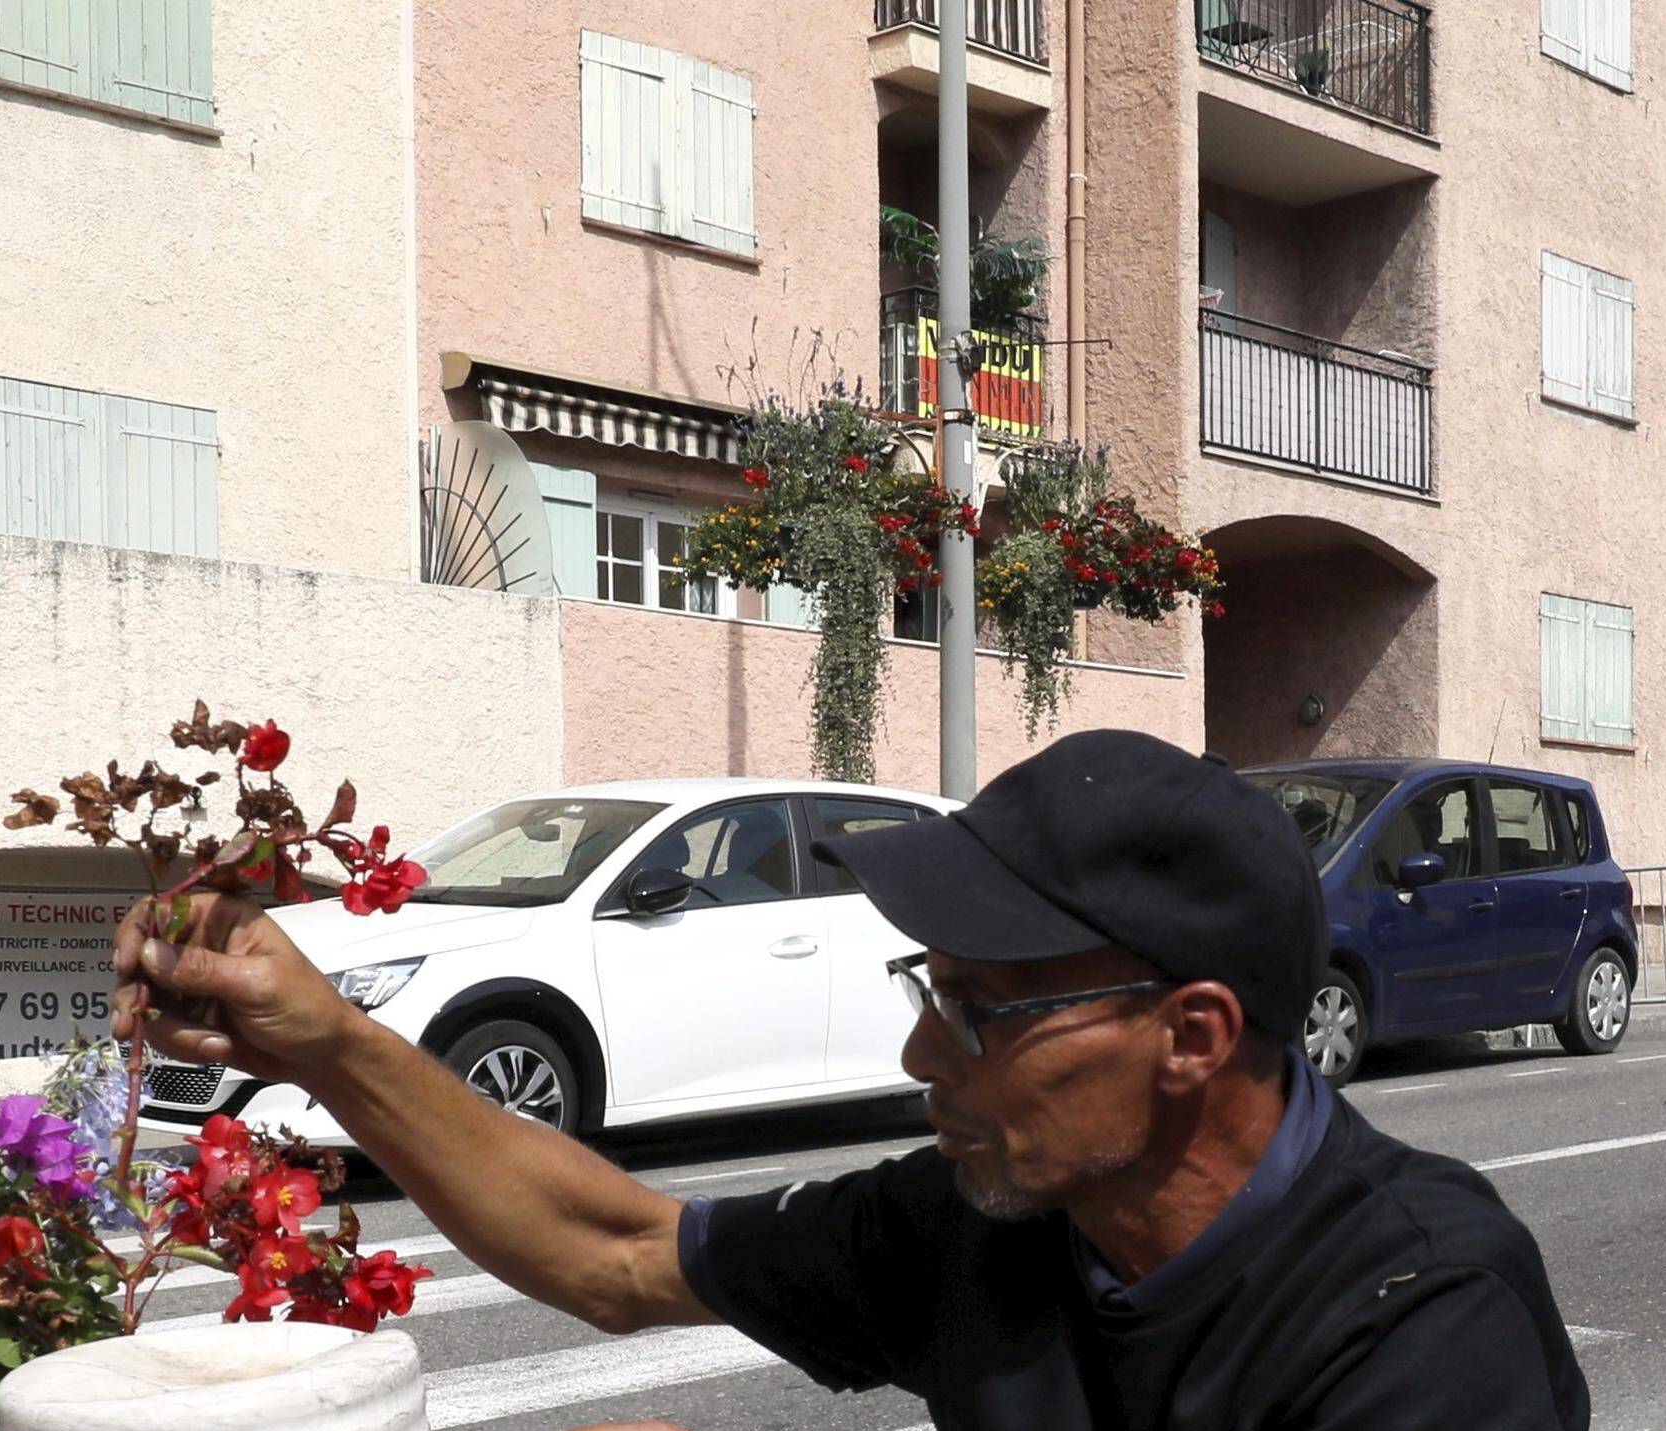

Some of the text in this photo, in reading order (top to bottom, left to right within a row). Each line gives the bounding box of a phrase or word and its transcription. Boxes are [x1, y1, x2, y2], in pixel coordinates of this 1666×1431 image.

[8, 904, 106, 924] TECHNIC
[19, 992, 59, 1021] 69
[70, 992, 109, 1020] 95
